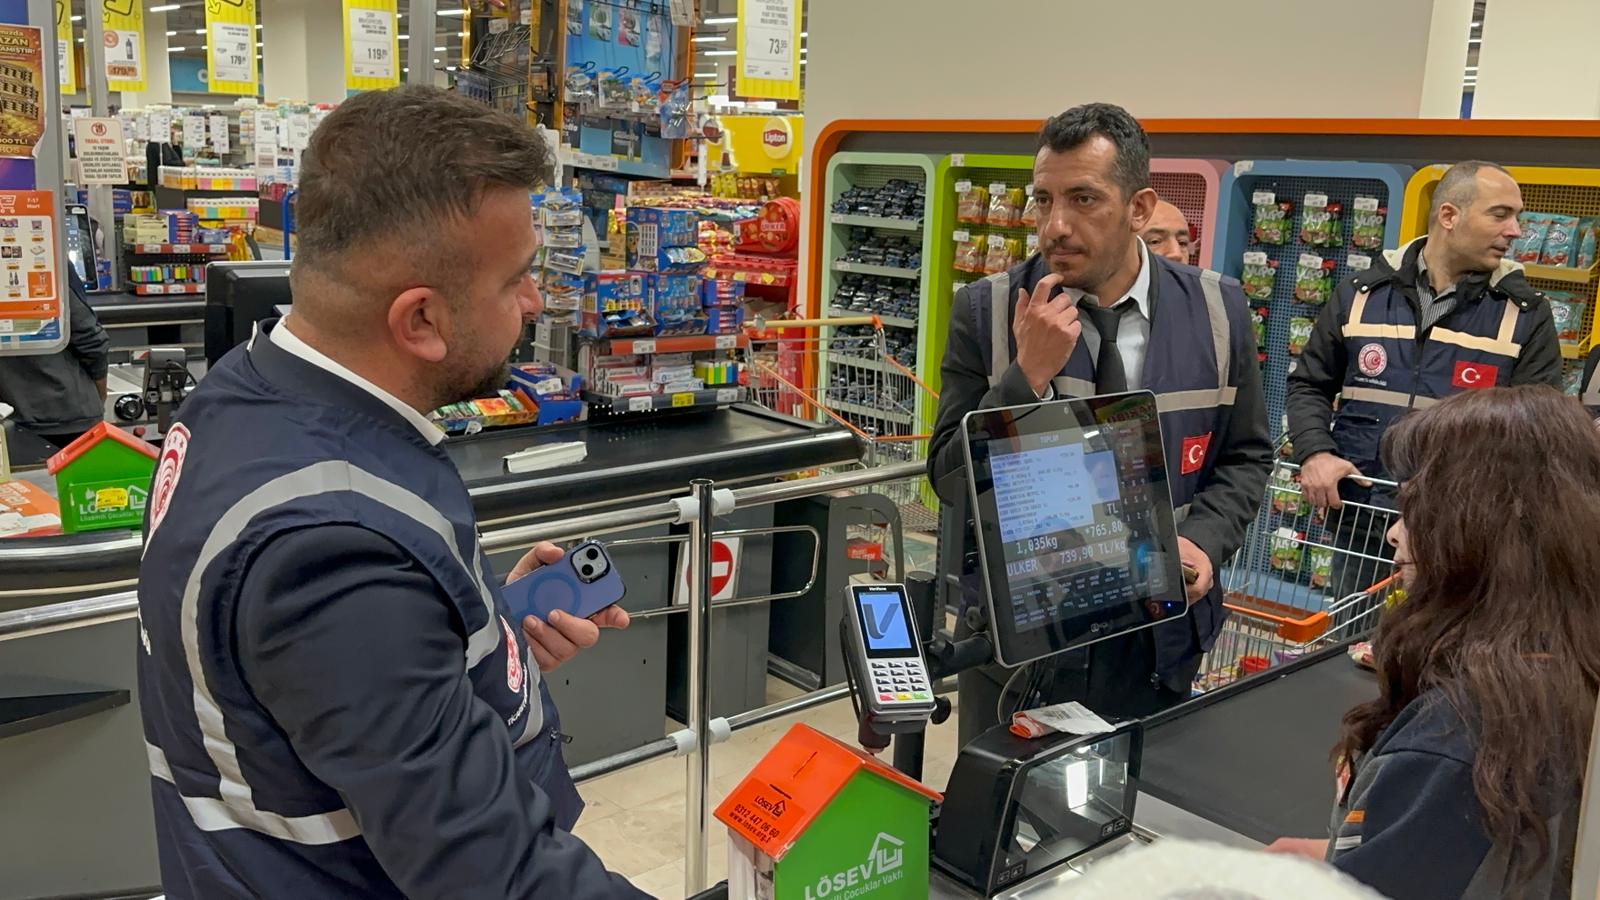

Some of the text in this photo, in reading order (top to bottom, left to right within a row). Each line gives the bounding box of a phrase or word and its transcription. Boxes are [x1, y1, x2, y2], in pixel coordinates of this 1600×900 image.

[0, 37, 28, 46] AZAN
[0, 46, 36, 54] AMIŞTIR!
[766, 133, 786, 141] Lipton
[1107, 503, 1119, 514] TL
[754, 795, 775, 811] LÖSEV
[734, 803, 751, 818] 0312
[750, 814, 763, 825] 447
[804, 860, 874, 900] LÖSEV
